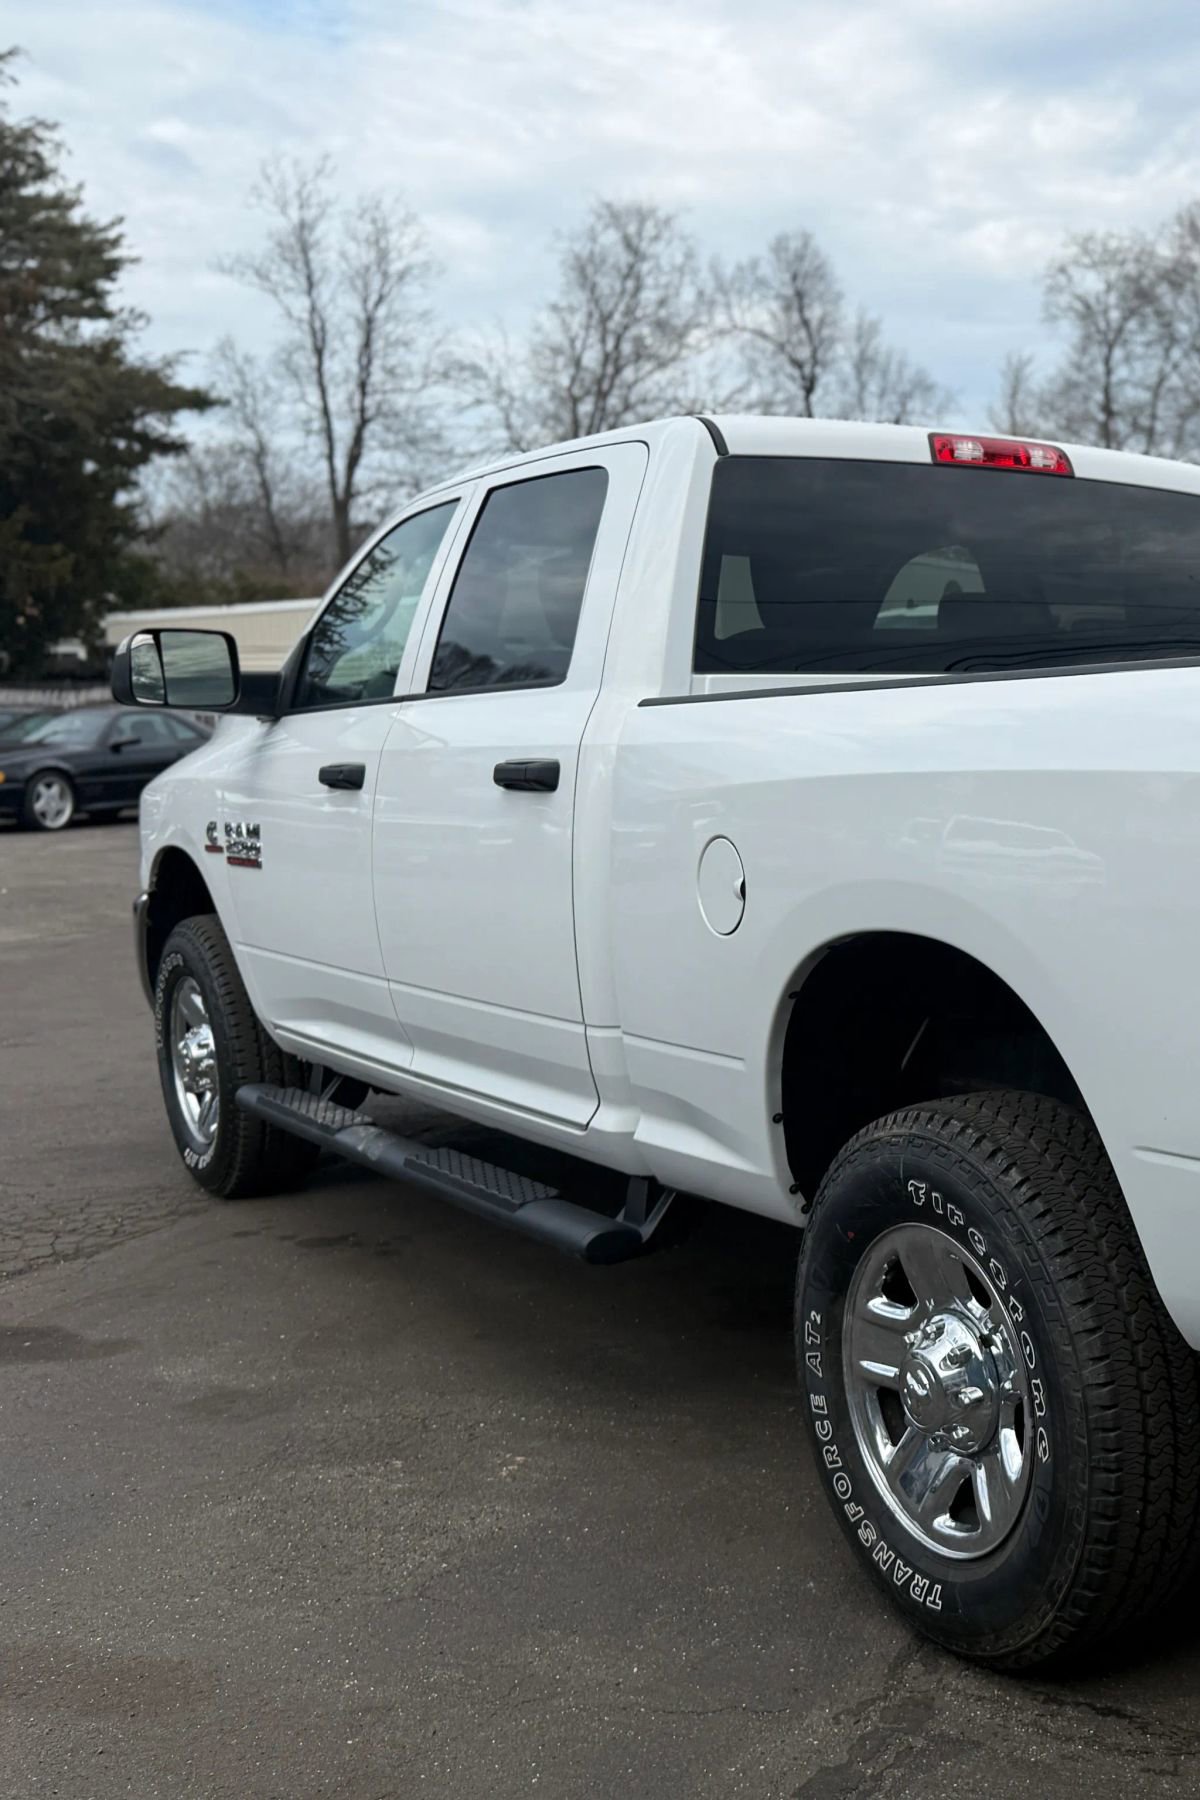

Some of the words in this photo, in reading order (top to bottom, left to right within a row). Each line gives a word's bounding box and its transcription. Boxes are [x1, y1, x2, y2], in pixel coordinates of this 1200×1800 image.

[804, 1310, 824, 1378] AT2
[908, 1179, 1050, 1464] Firestone
[810, 1392, 942, 1610] TRANSFORCE
